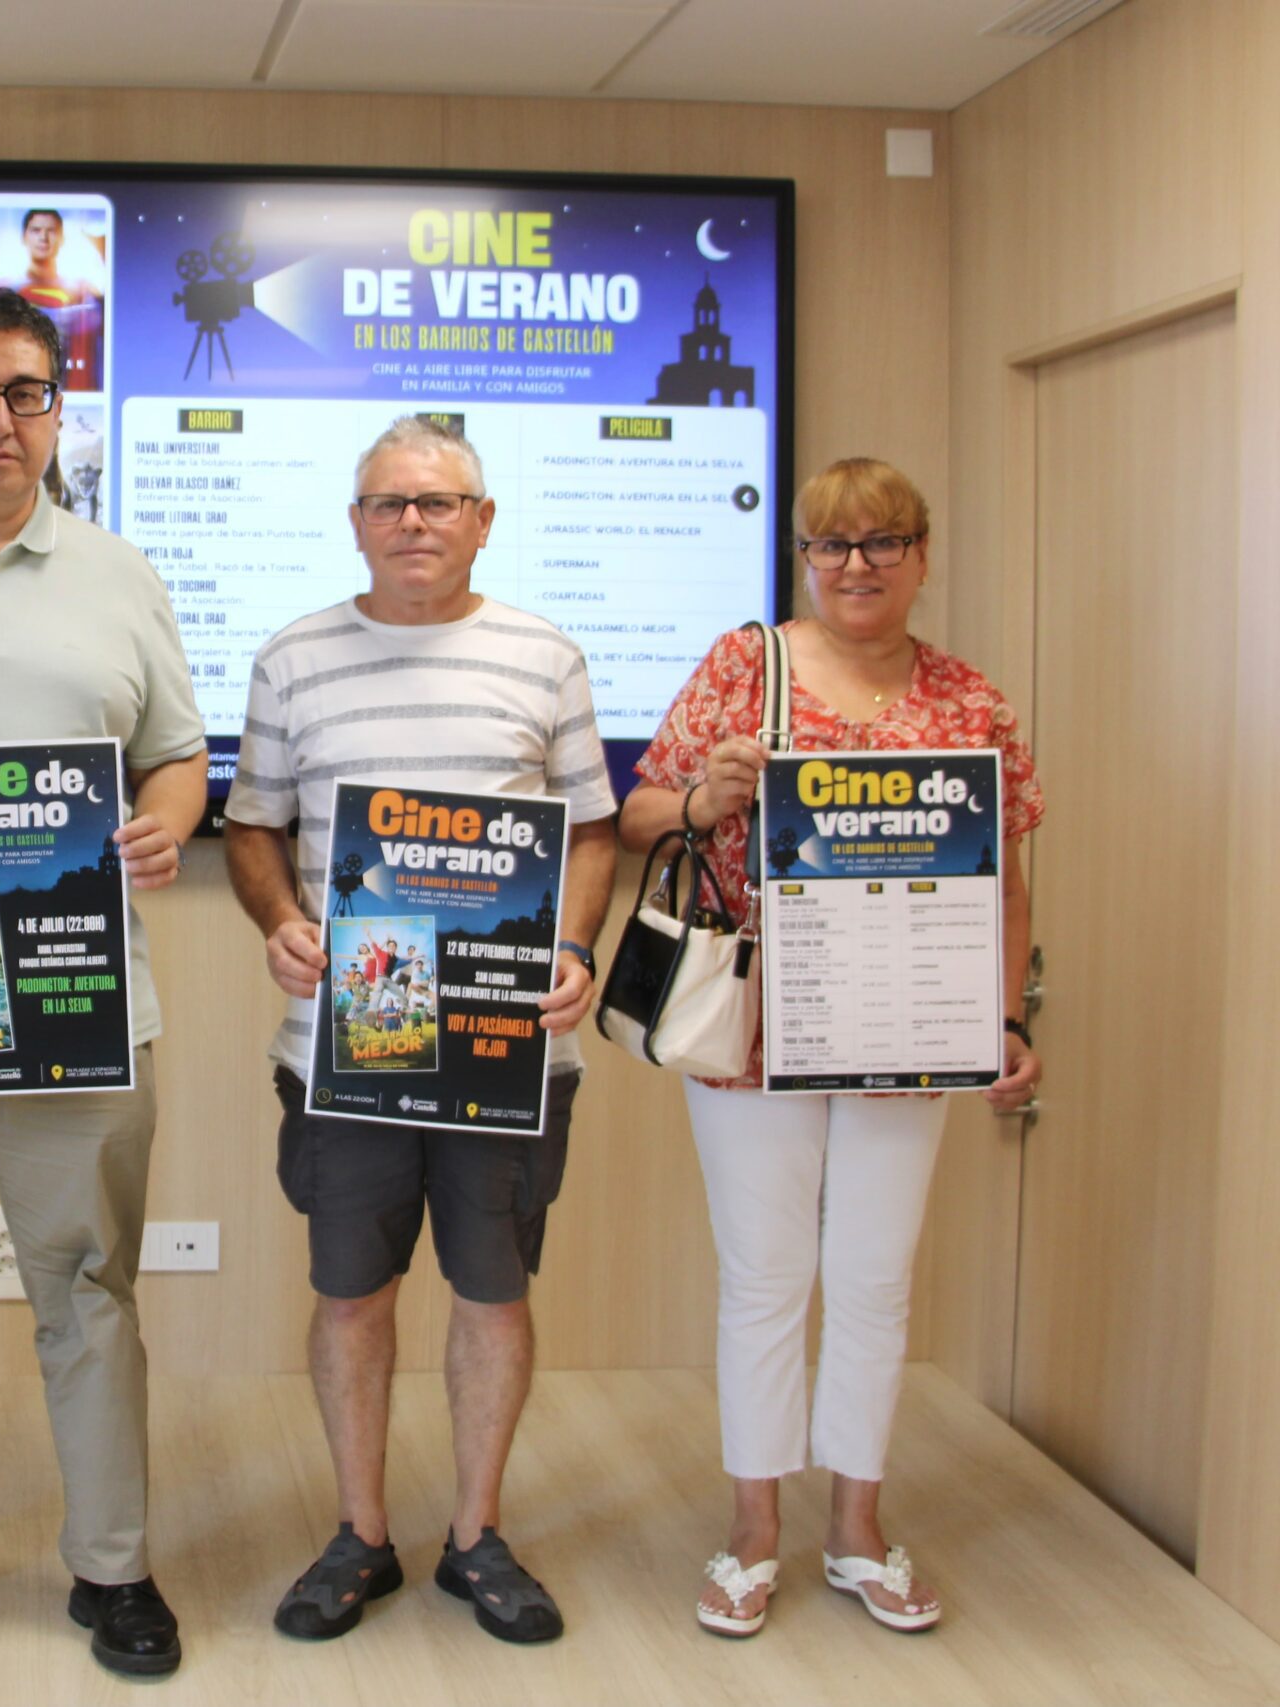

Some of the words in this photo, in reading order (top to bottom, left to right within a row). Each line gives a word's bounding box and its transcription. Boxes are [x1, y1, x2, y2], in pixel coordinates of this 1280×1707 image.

[409, 210, 552, 266] CINE
[343, 268, 412, 317] DE
[430, 270, 639, 323] VERANO
[354, 324, 373, 348] EN
[382, 325, 411, 350] LOS
[419, 326, 489, 351] BARRIOS
[497, 327, 516, 352] DE
[524, 325, 613, 354] CASTELLÓN
[372, 363, 401, 374] CINE
[405, 364, 419, 375] AL
[424, 364, 451, 375] AIRE
[454, 364, 488, 376] LIBRE
[492, 366, 522, 376] PARA
[526, 366, 591, 378] DISFRUTAR
[402, 380, 418, 391] EN
[422, 380, 470, 392] FAMILIA
[474, 381, 482, 392] Y
[486, 381, 512, 393] CON
[516, 382, 564, 393] AMIGOS
[188, 411, 232, 429] BARRIO
[610, 417, 662, 437] PELÍCULA
[134, 441, 160, 454] RAVAL
[164, 442, 220, 454] UNIVERSITARI
[135, 476, 172, 490] BULEVAR
[176, 477, 208, 490] BLASCO
[212, 475, 241, 490] IBAÑEZ
[712, 494, 734, 503] SEL
[134, 510, 165, 523] PARQUE
[169, 511, 201, 523] LITORAL
[205, 512, 227, 524] GRAO
[139, 547, 168, 559] ENYETA
[172, 547, 193, 559] ROJA
[543, 560, 599, 568] SUPERMAN
[178, 580, 216, 592] SOCORRO
[542, 592, 605, 601] COARTADAS
[204, 612, 225, 624] GRAO
[642, 625, 675, 633] MEJOR
[34, 759, 85, 795] de
[797, 760, 913, 807] Cine
[918, 770, 967, 804] de
[368, 789, 482, 843] Cine
[486, 812, 534, 847] de
[813, 810, 950, 837] verano
[380, 841, 515, 877] verano
[18, 918, 24, 933] 4
[26, 918, 37, 933] DE
[40, 917, 64, 933] JULIO
[66, 914, 105, 933] (22:00H)
[447, 941, 457, 955] 12
[458, 942, 468, 956] DE
[470, 943, 516, 960] SEPTIEMBRE
[517, 946, 551, 963] (22:00H)
[17, 977, 72, 993] PADDINGTON:
[75, 975, 116, 991] AVENTURA
[475, 971, 488, 983] SAN
[488, 972, 515, 985] LORENZO
[43, 998, 53, 1014] EN
[56, 998, 65, 1013] LA
[68, 997, 92, 1013] SELVA
[448, 1014, 466, 1031] VOY
[468, 1016, 474, 1033] A
[477, 1014, 533, 1037] PASÁRMELO
[352, 1036, 423, 1061] MEJOR
[473, 1038, 507, 1057] MEJOR
